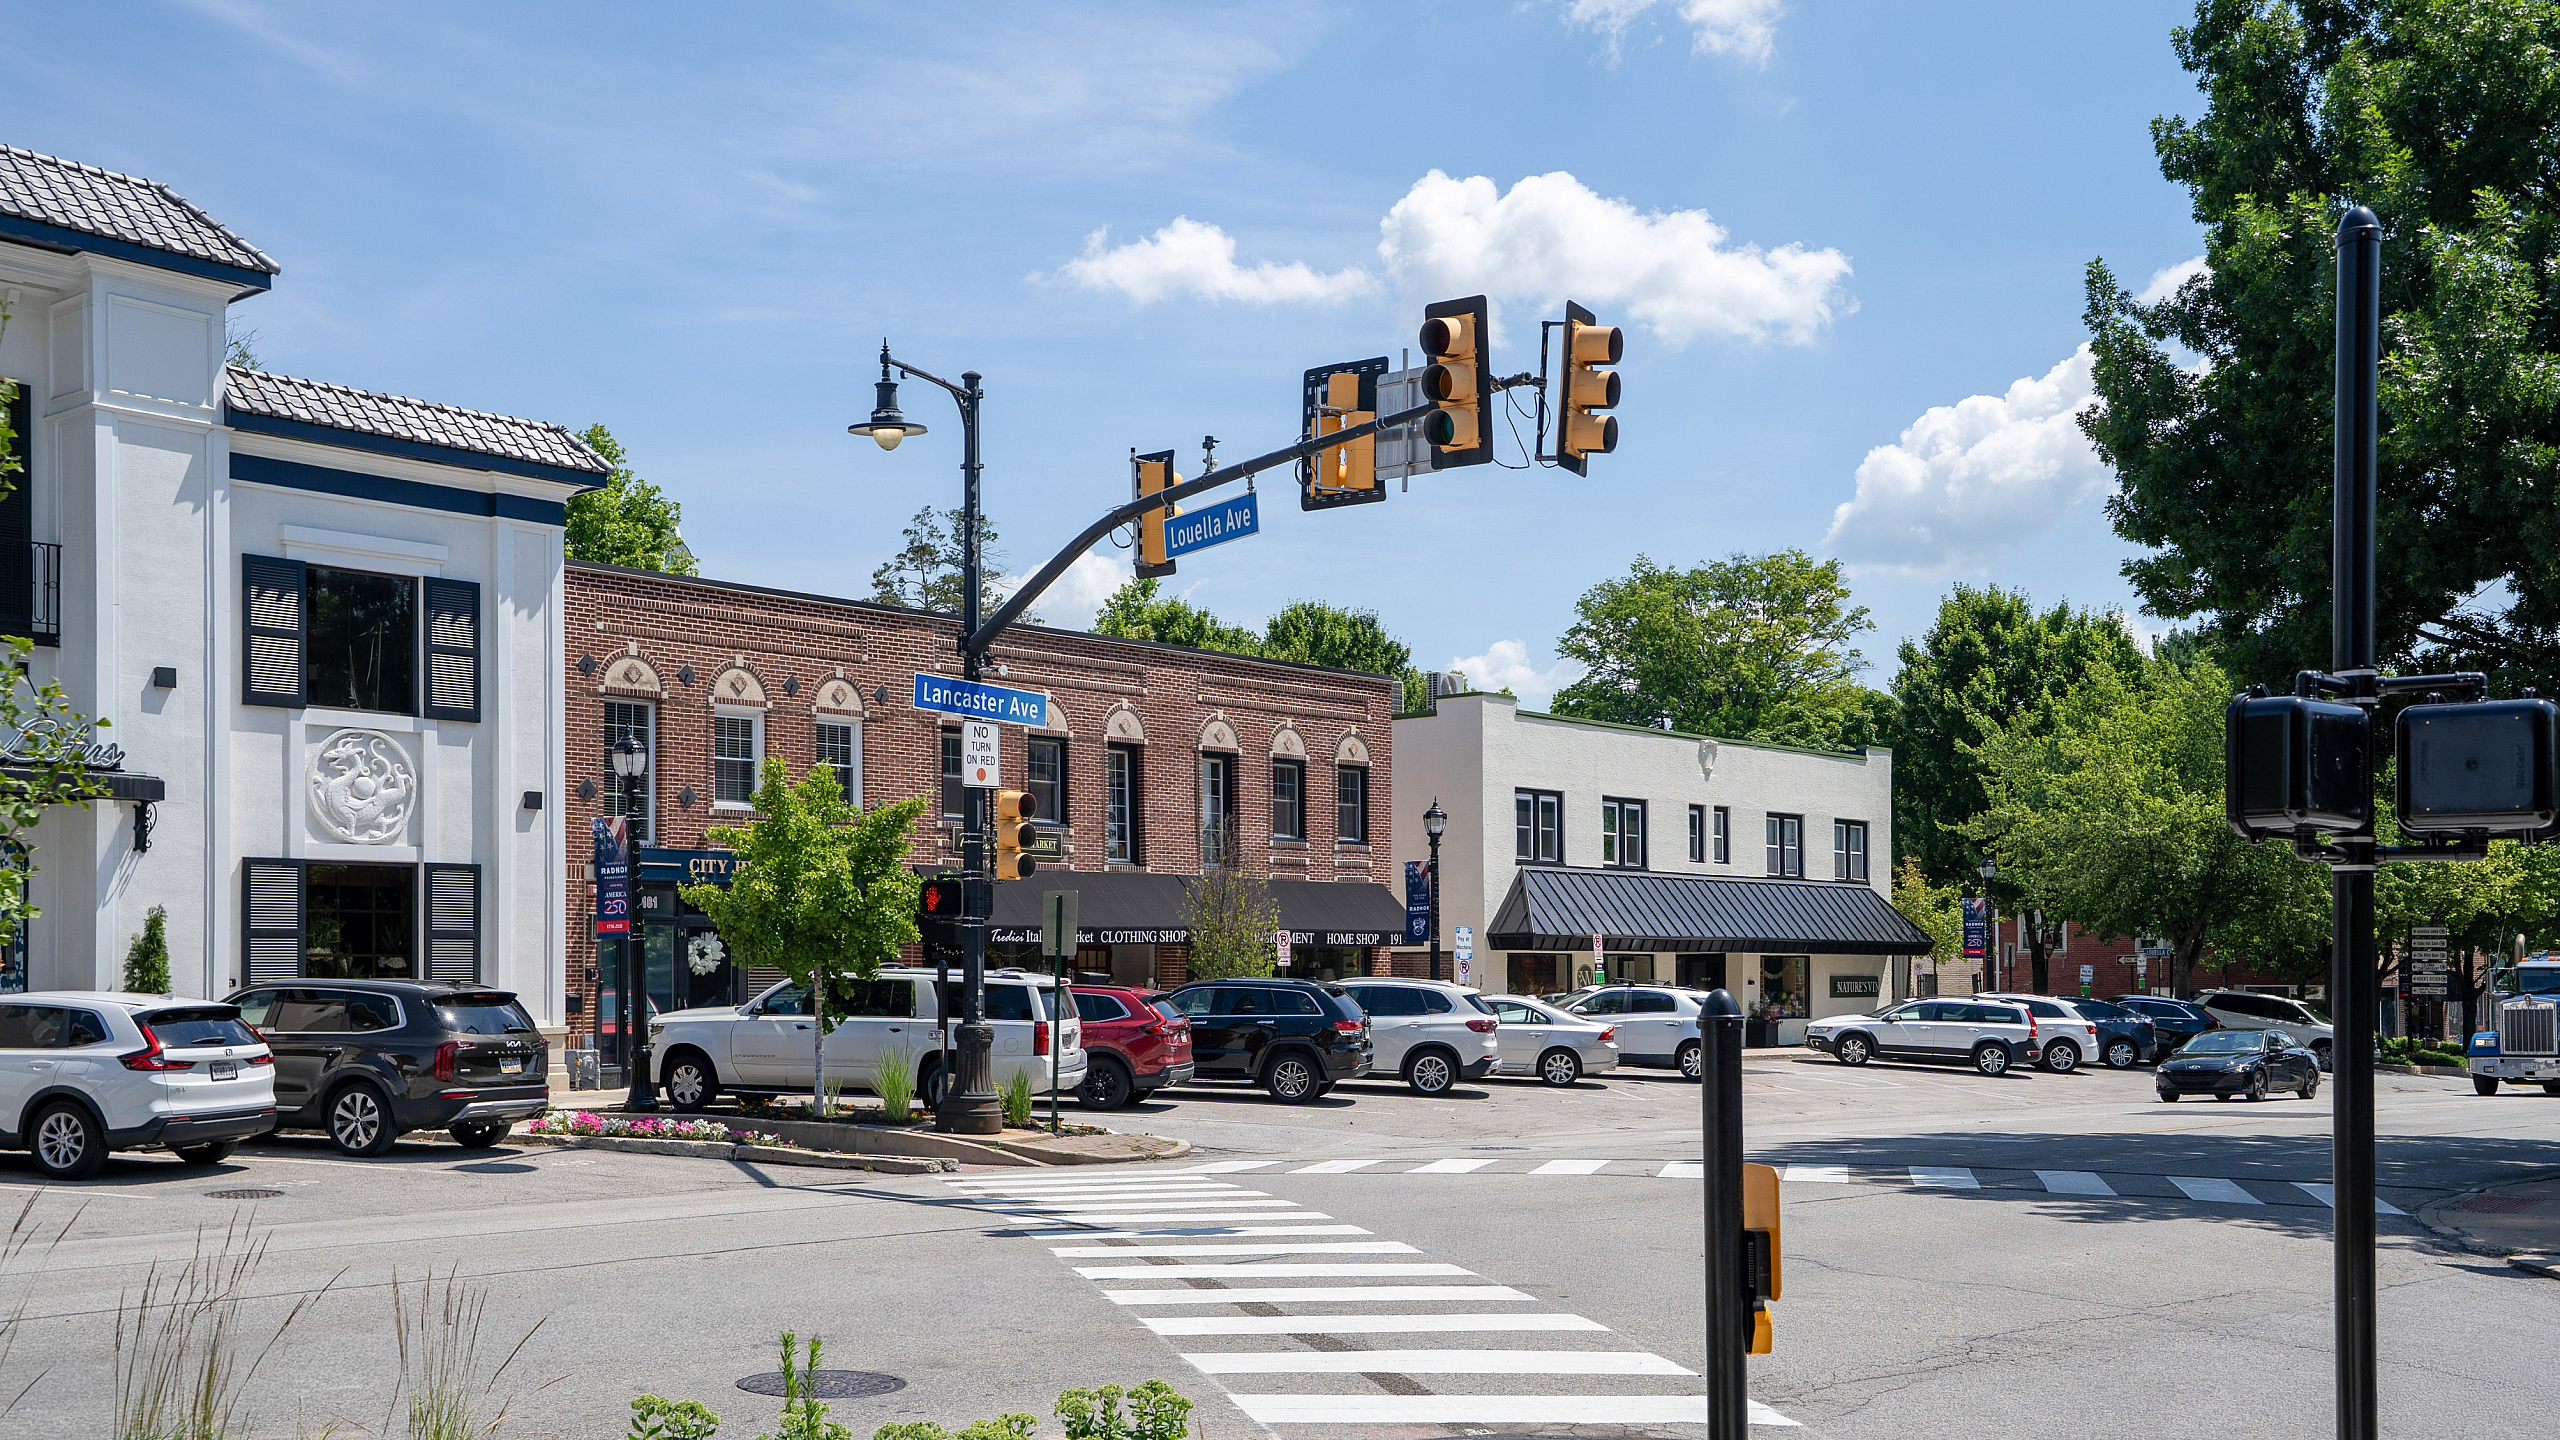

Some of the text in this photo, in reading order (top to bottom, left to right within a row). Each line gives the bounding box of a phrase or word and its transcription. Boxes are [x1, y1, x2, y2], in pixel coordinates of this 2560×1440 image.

[1170, 508, 1251, 549] Louella Ave
[923, 682, 1039, 719] Lancaster Ave
[973, 726, 989, 739] NO
[971, 741, 991, 752] TURN
[966, 754, 996, 766] ON RED
[1031, 840, 1058, 850] ARKET
[689, 858, 729, 874] CITY
[604, 898, 627, 915] 250
[991, 928, 1024, 942] Tredici
[1100, 930, 1157, 943] CLOTHING
[1159, 930, 1187, 943] SHOP
[1326, 933, 1402, 945] HOME SHOP 191
[1836, 981, 1868, 993] NATURE'S
